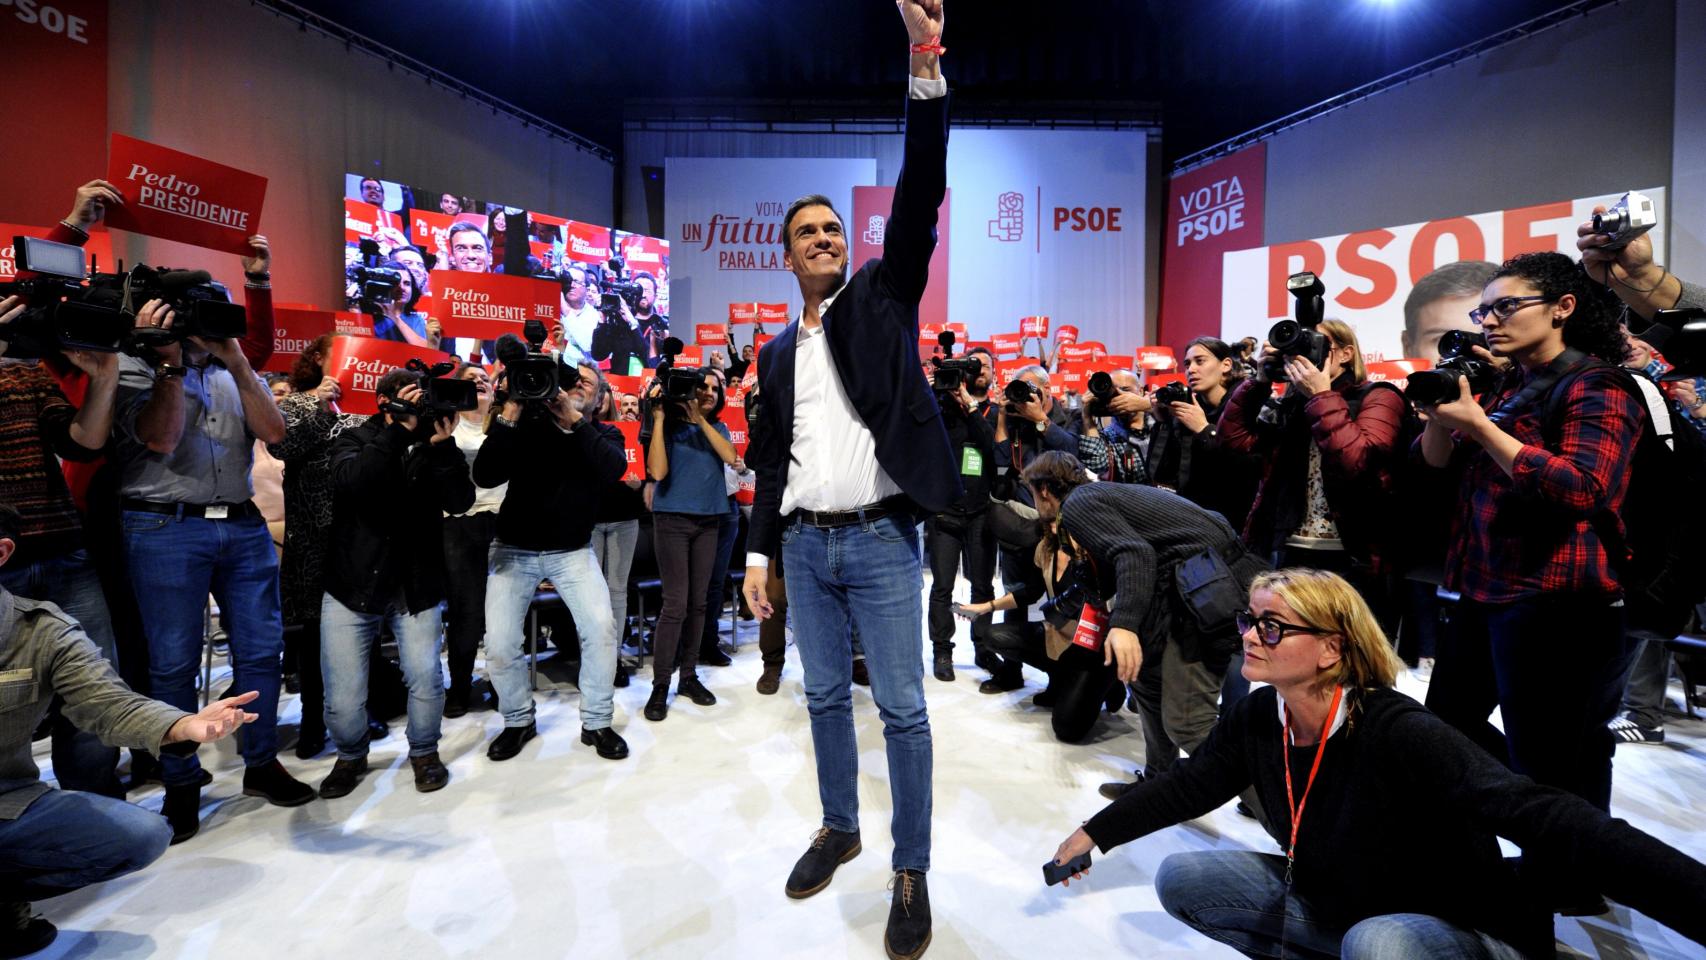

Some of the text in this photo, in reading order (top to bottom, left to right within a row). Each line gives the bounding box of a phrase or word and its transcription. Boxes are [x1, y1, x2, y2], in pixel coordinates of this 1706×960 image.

[0, 0, 88, 44] SOE
[126, 163, 200, 197] Pedro
[1180, 175, 1245, 216] VOTA
[140, 186, 249, 228] PRESIDENTE
[755, 201, 784, 217] VOTA
[1054, 207, 1122, 232] PSOE
[1178, 202, 1245, 247] PSOE
[682, 223, 701, 241] UN
[719, 252, 755, 268] PARA
[760, 252, 777, 268] LA
[442, 287, 490, 303] Pedro
[452, 302, 527, 320] PRESIDENTE
[274, 339, 312, 352] SIDEN
[342, 356, 400, 374] Pedro
